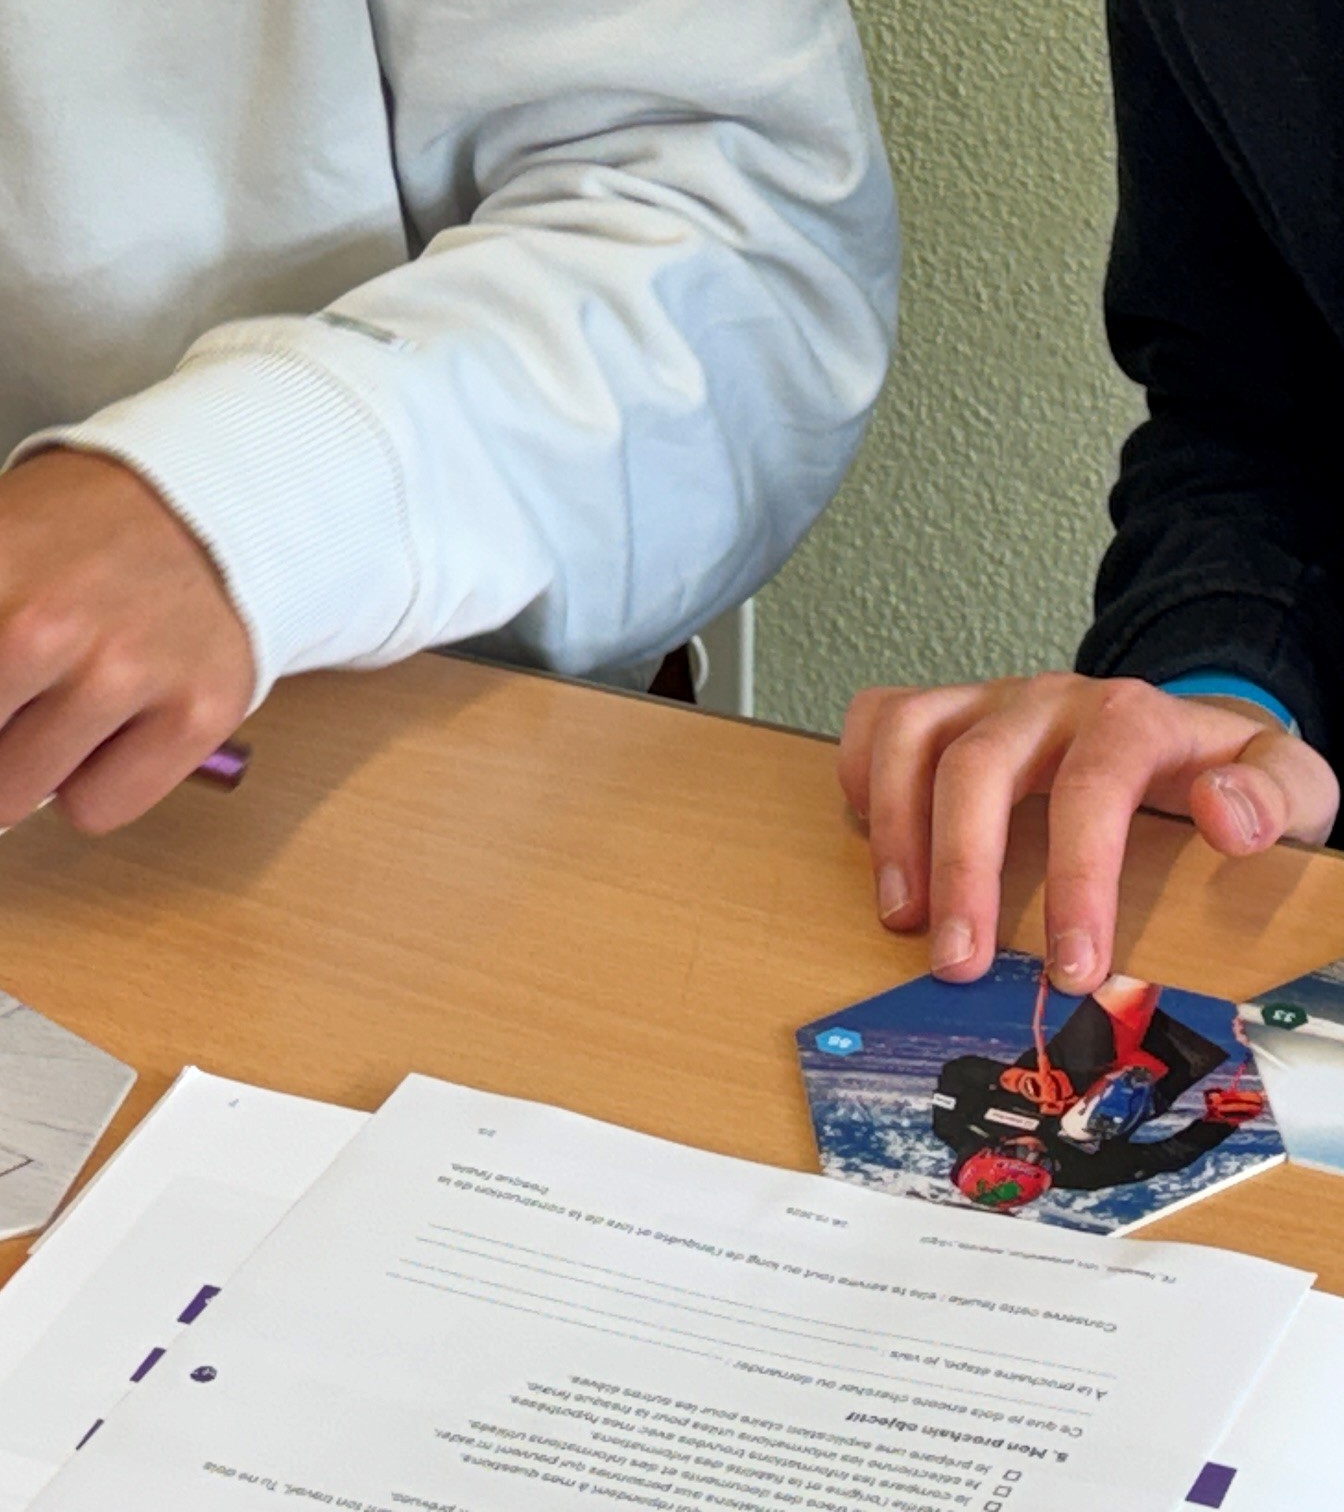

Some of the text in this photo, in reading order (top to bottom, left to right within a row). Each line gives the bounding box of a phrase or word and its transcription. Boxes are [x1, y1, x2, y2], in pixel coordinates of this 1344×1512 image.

[844, 1411, 918, 1431] objectif
[920, 1425, 1005, 1448] prochain
[1007, 1441, 1048, 1459] Mon
